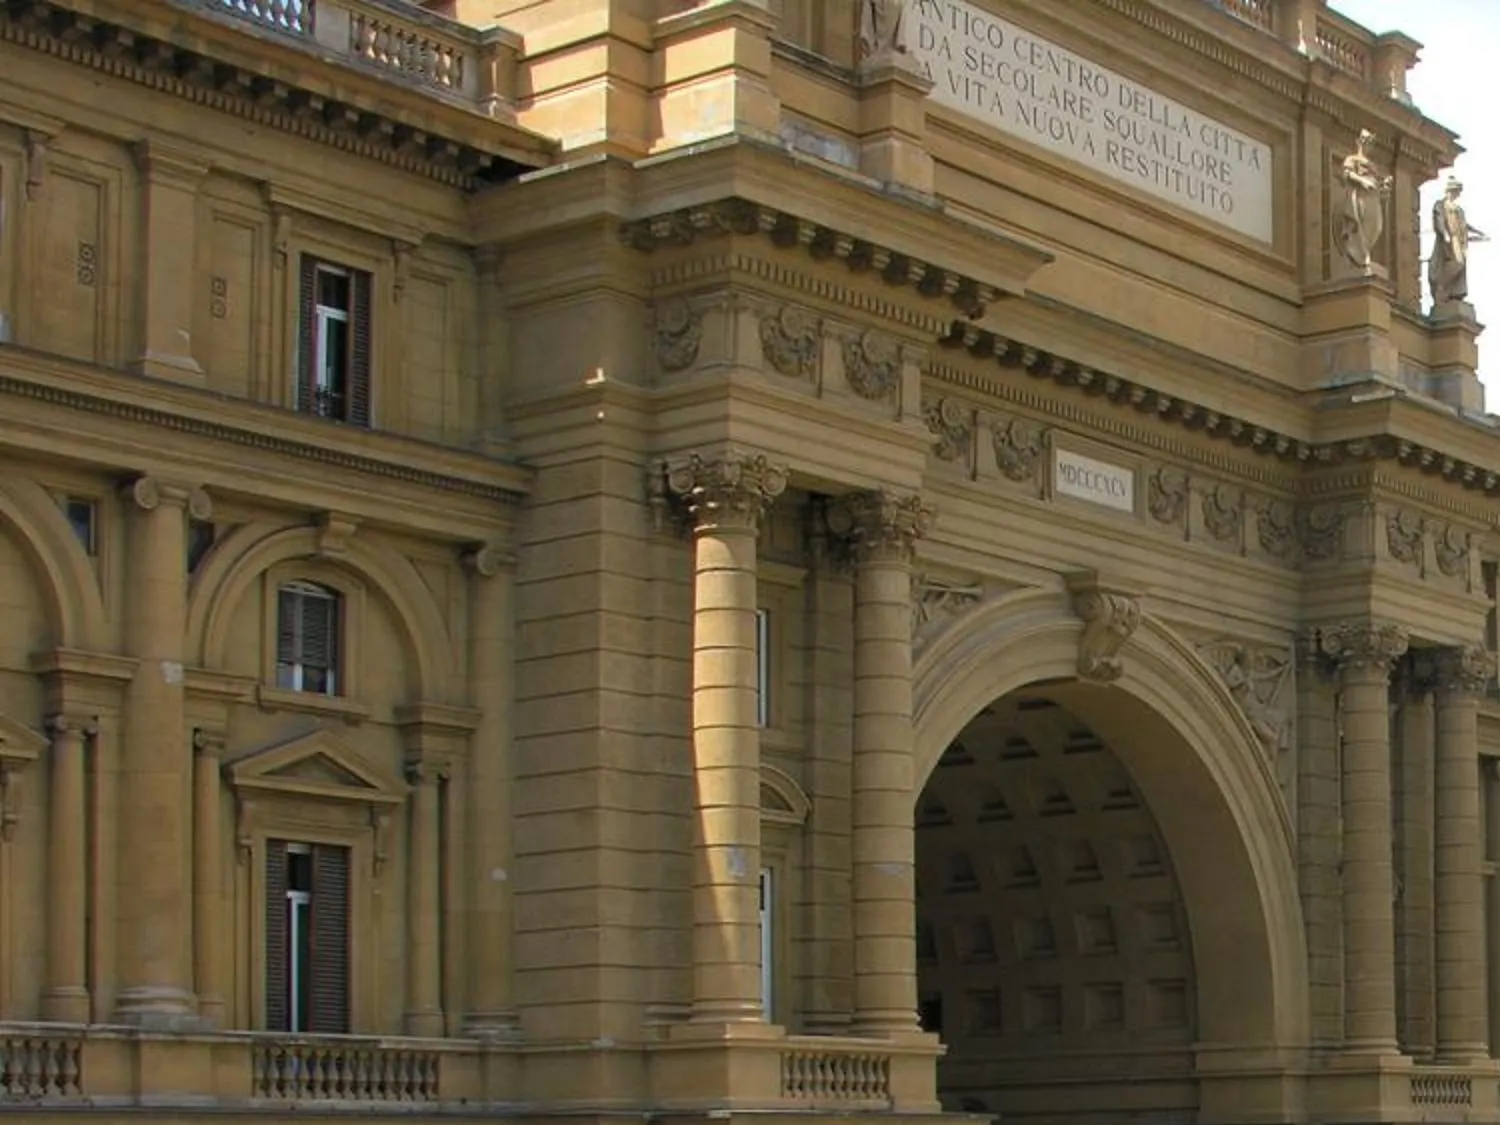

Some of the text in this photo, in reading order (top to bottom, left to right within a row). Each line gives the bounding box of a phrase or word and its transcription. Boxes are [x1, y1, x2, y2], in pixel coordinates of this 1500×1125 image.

[911, 0, 1004, 49] ANTICO
[1013, 37, 1109, 98] CENTRO
[1119, 84, 1192, 138] DELLA
[918, 61, 1234, 214] A VITA NUOVA RESTITUITO
[919, 23, 1233, 186] DA SECOLARE SQUALLORE
